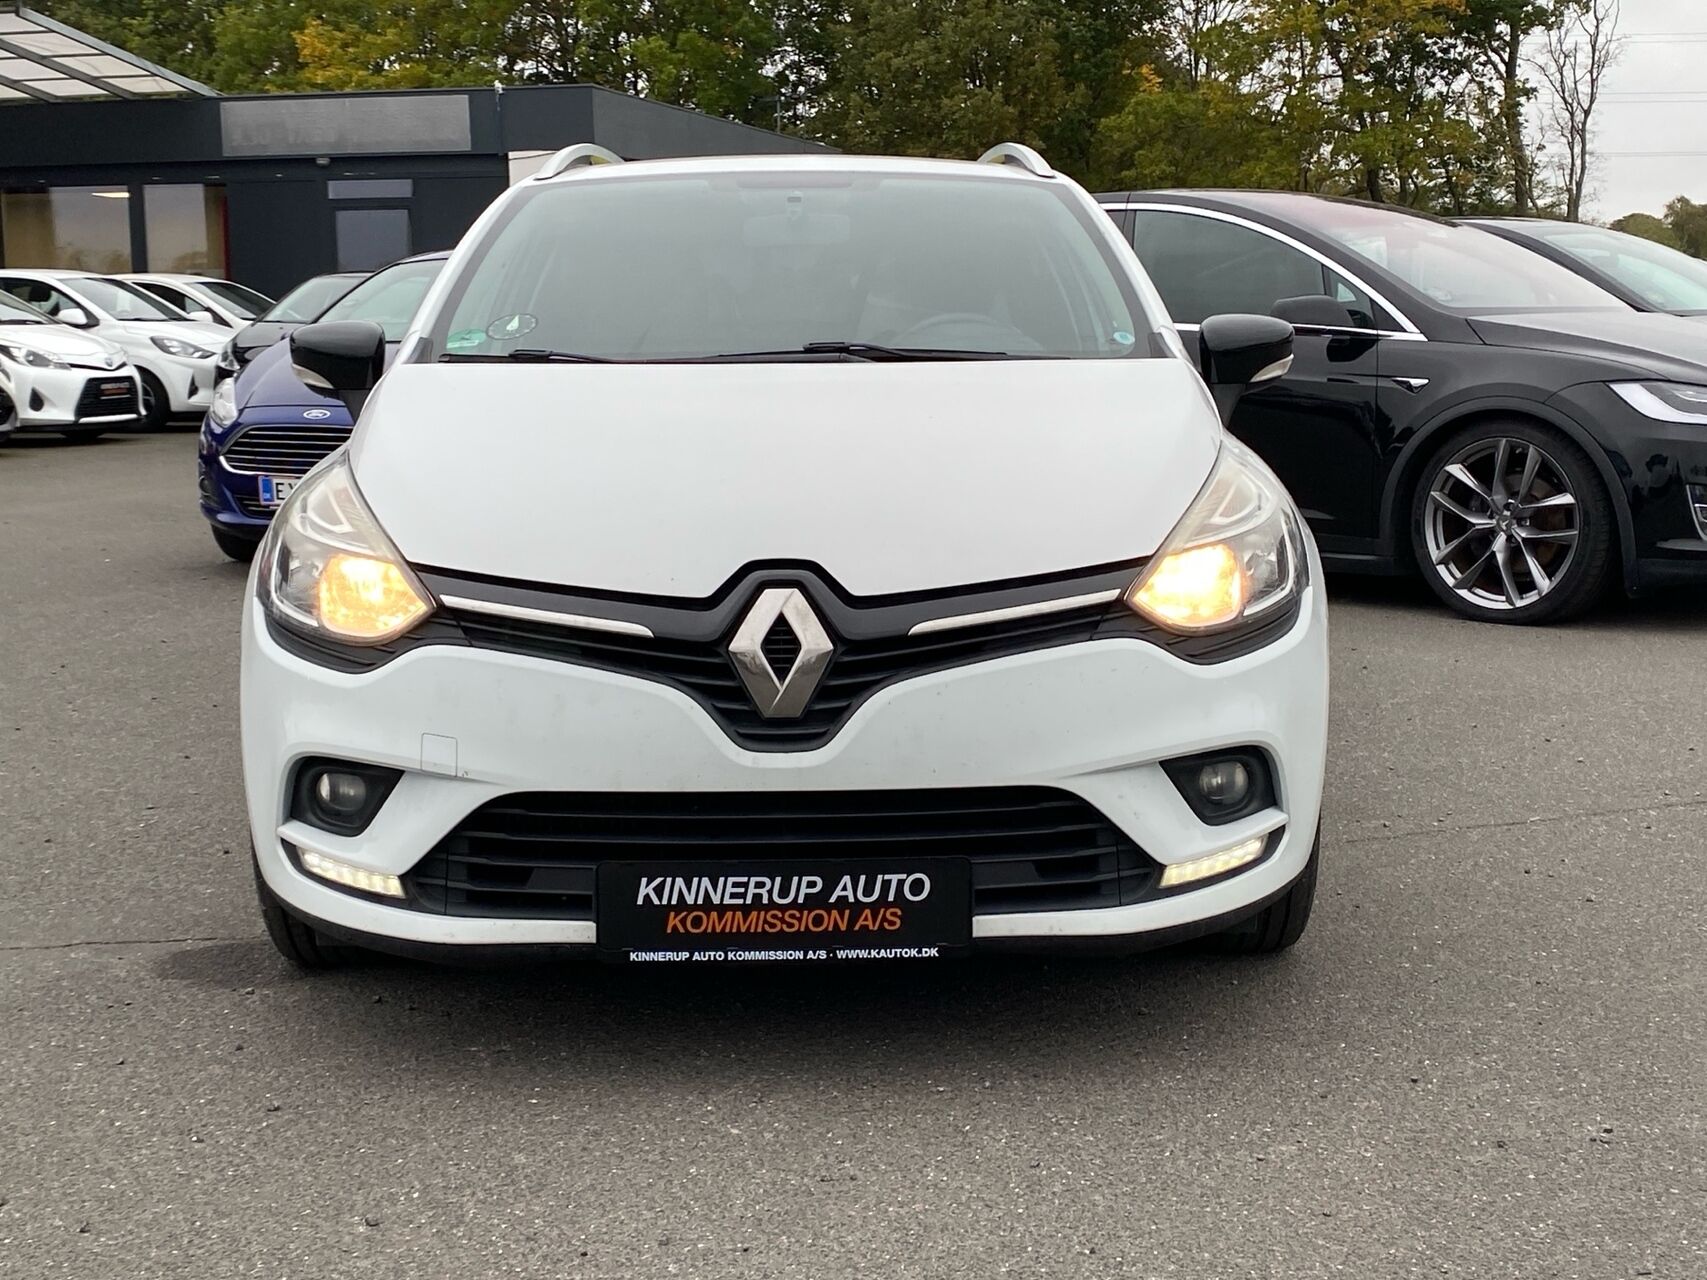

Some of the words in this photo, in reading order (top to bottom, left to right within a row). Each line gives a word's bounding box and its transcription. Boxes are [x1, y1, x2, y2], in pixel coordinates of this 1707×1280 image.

[636, 876, 823, 905] KINNERUP
[827, 873, 931, 902] AUTO
[666, 909, 850, 933] KOMMISSION
[853, 908, 902, 930] A/S
[629, 952, 690, 961] KINNERUP
[692, 952, 725, 961] AUTO
[727, 950, 804, 961] KOMMISSION
[806, 950, 827, 960] A/S
[836, 947, 939, 959] WWW.KAUTOK.DK
